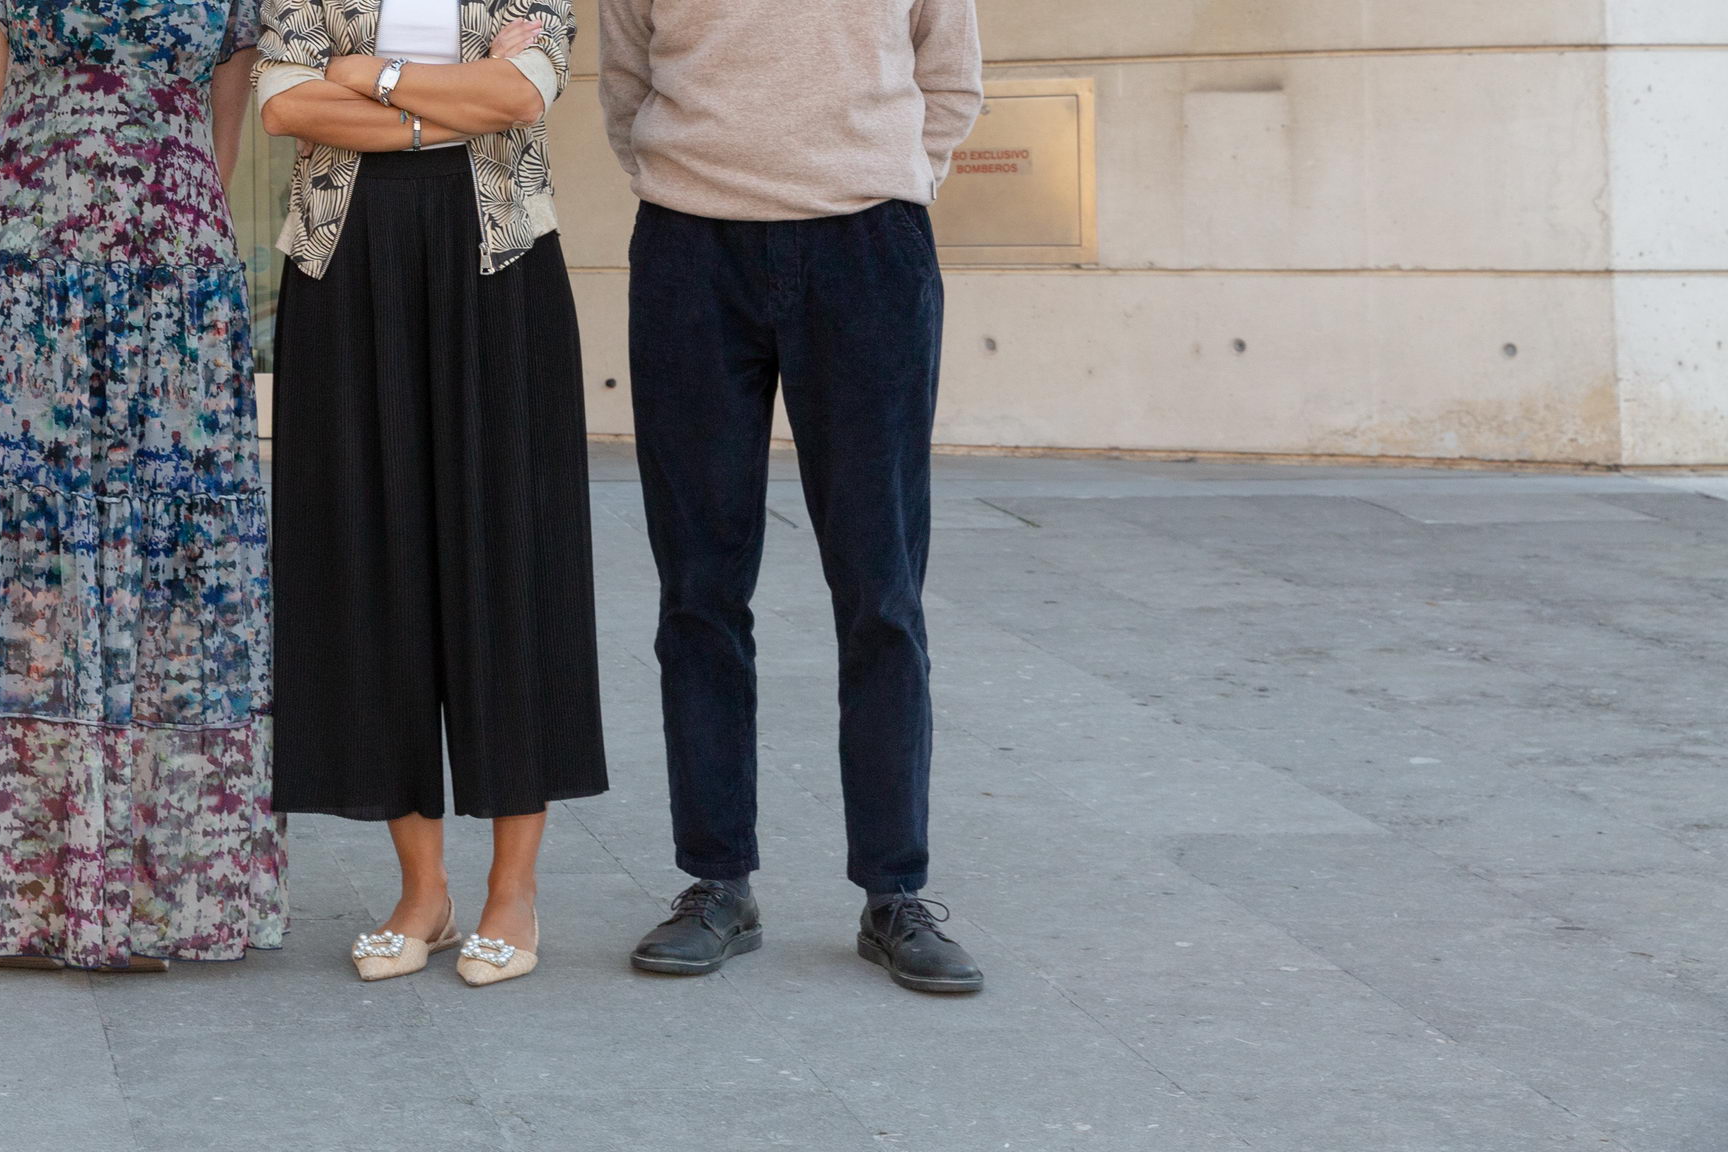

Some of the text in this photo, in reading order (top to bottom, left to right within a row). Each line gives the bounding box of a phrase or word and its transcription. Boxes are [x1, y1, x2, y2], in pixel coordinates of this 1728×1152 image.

[952, 149, 1030, 160] SO EXCLUSIVO
[956, 163, 1018, 174] BOMBEROS
